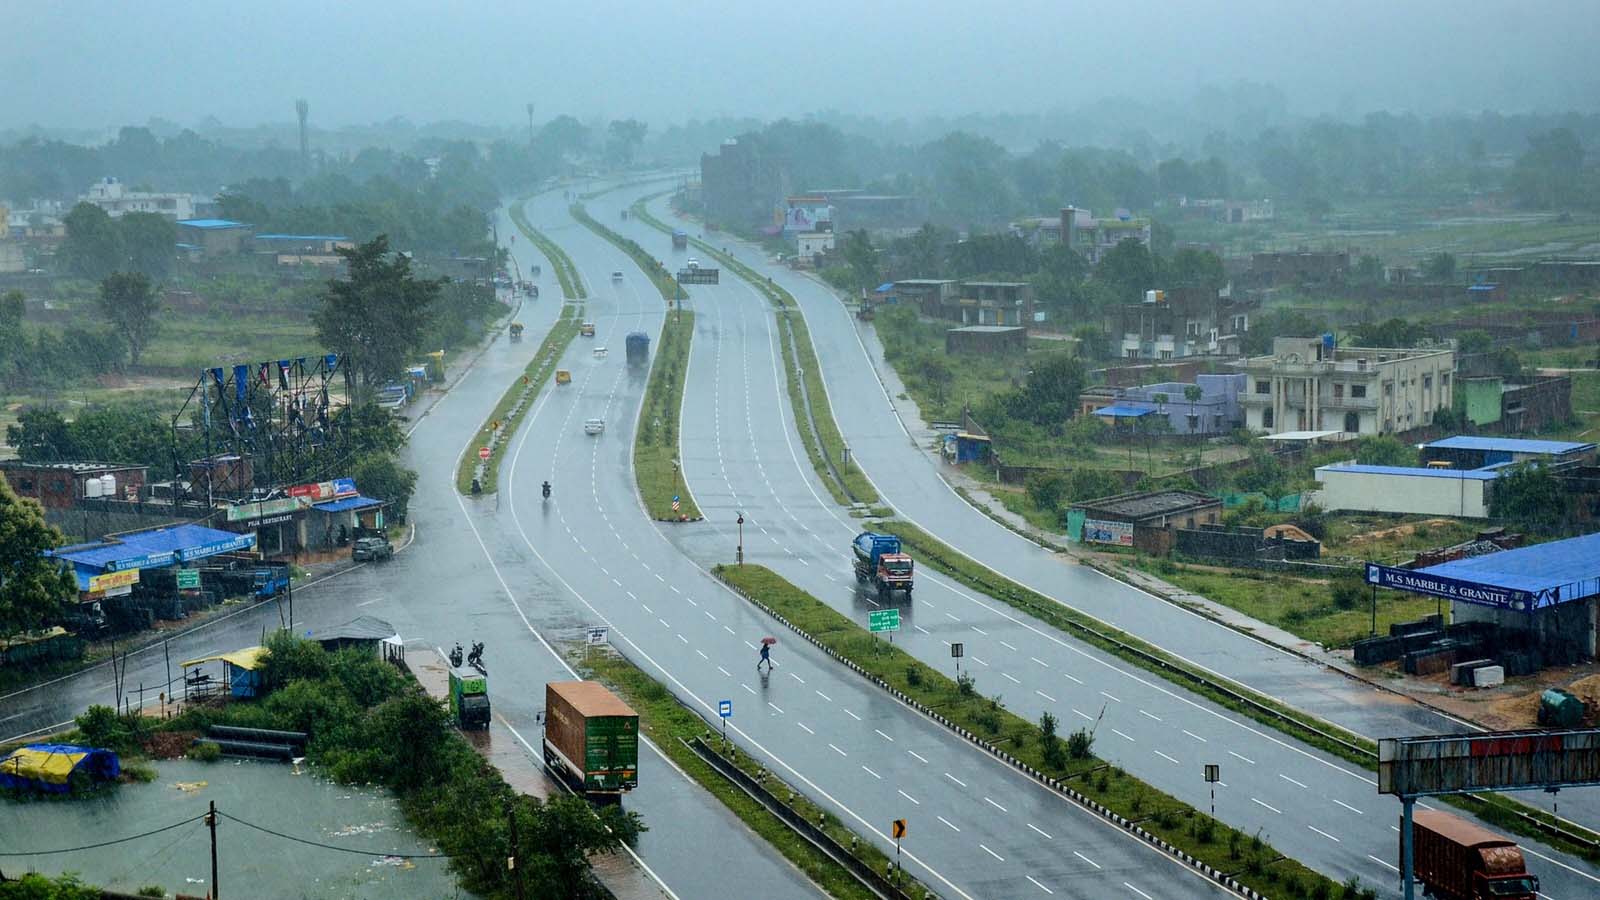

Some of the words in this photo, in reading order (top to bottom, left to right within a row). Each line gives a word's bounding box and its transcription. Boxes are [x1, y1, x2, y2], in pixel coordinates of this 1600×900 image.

[1385, 573, 1403, 584] M.S
[1405, 576, 1447, 592] MARBLE
[1449, 585, 1457, 594] &
[1459, 587, 1508, 604] GRANITE
